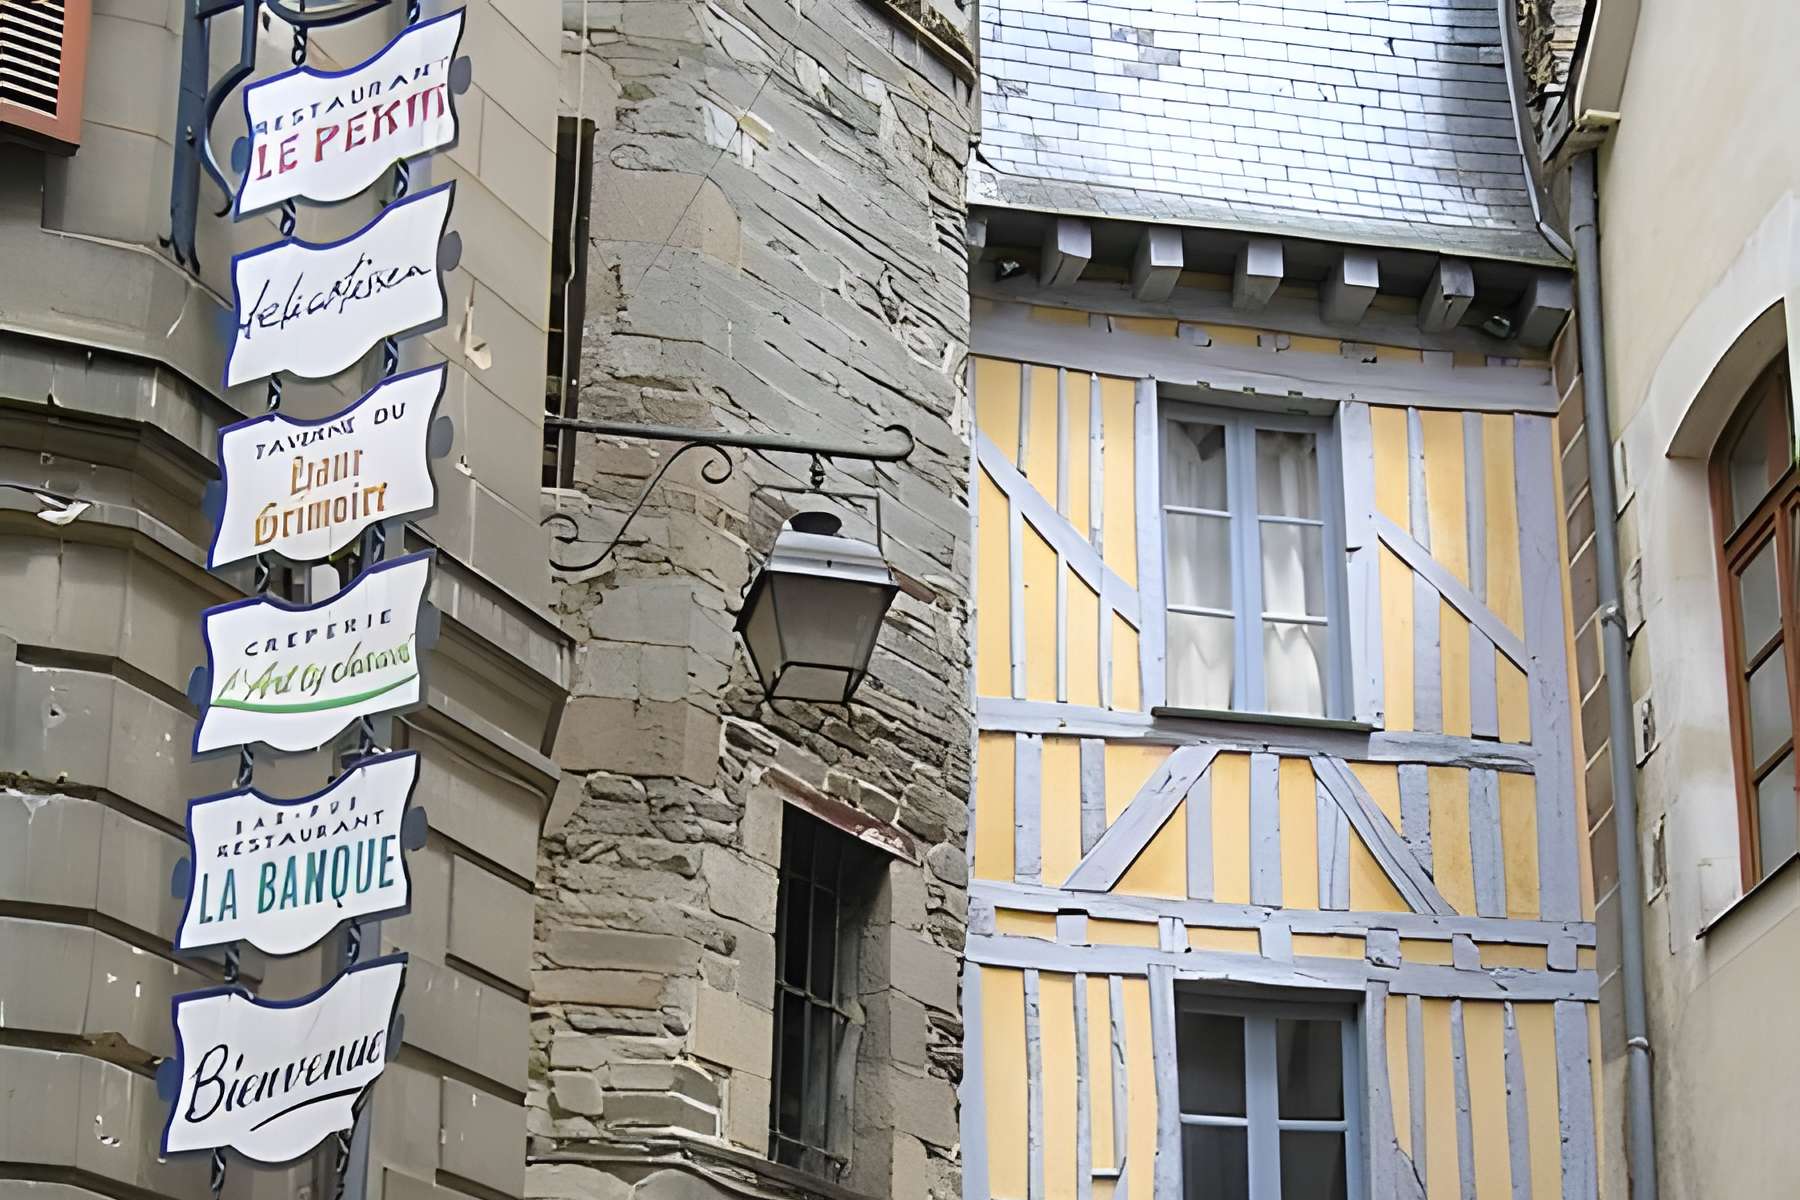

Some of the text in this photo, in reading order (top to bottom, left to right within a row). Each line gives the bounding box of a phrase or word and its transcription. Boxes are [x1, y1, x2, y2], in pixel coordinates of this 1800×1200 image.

[256, 83, 446, 181] LE PEKIN
[373, 402, 406, 426] DU
[199, 834, 397, 925] LA BANQUE
[216, 809, 385, 859] RESTAURANT
[184, 1029, 385, 1124] Bienvenue
